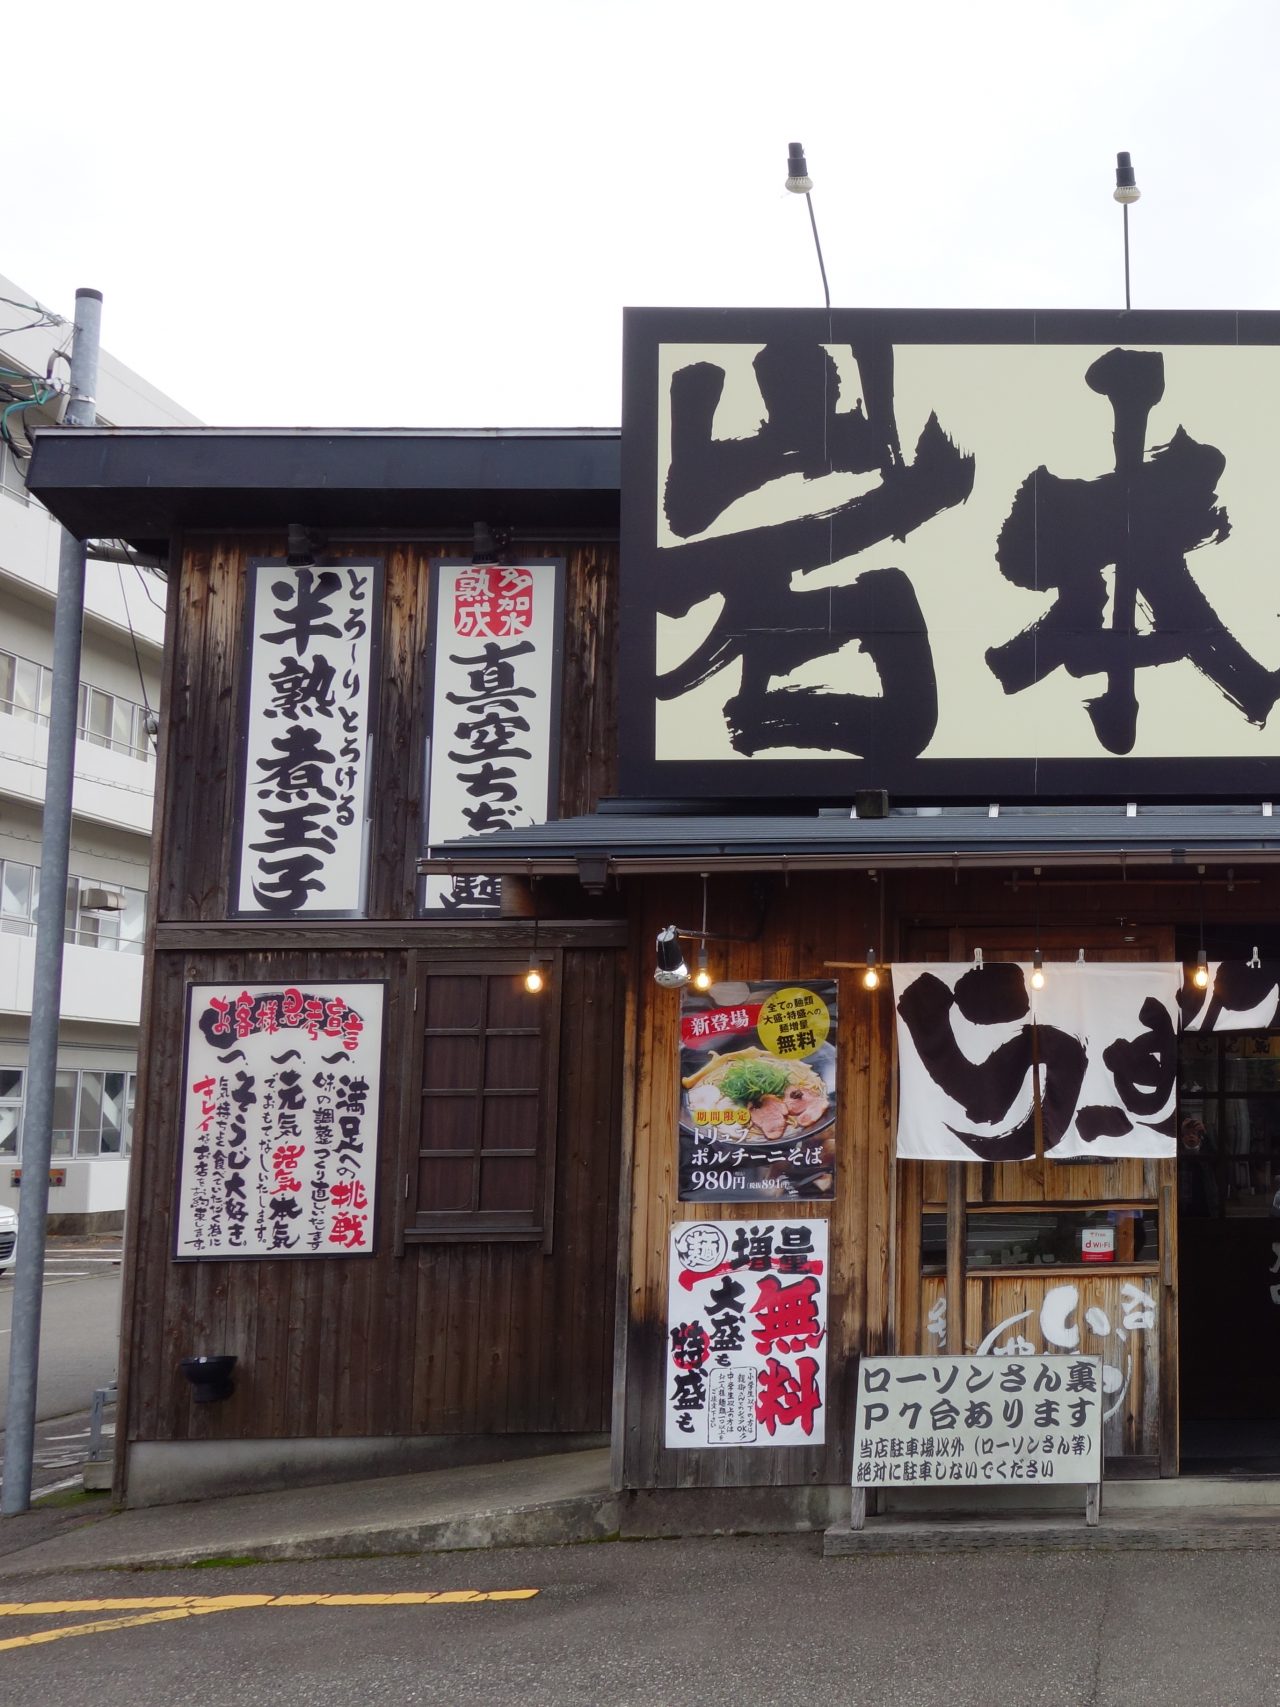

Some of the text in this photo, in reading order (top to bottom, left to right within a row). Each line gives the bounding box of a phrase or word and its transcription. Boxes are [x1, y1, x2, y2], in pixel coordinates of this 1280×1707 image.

[454, 570, 496, 637] 熟成
[498, 568, 533, 636] 多加水
[249, 568, 343, 911] 半熟煮玉子
[438, 640, 537, 909] 真空ちぢ
[690, 1008, 750, 1037] 新登場
[776, 1029, 817, 1055] 無料
[693, 1127, 750, 1145] トリュフ
[696, 1110, 749, 1123] 期間限定
[691, 1146, 823, 1167] ポルチーニそば
[703, 1275, 746, 1368] 大盛も
[670, 1320, 711, 1434] 特盛も
[748, 1273, 828, 1437] 無料
[863, 1360, 1098, 1394] ローソンさん裏
[856, 1459, 1055, 1483] 絶対に駐車しないでください
